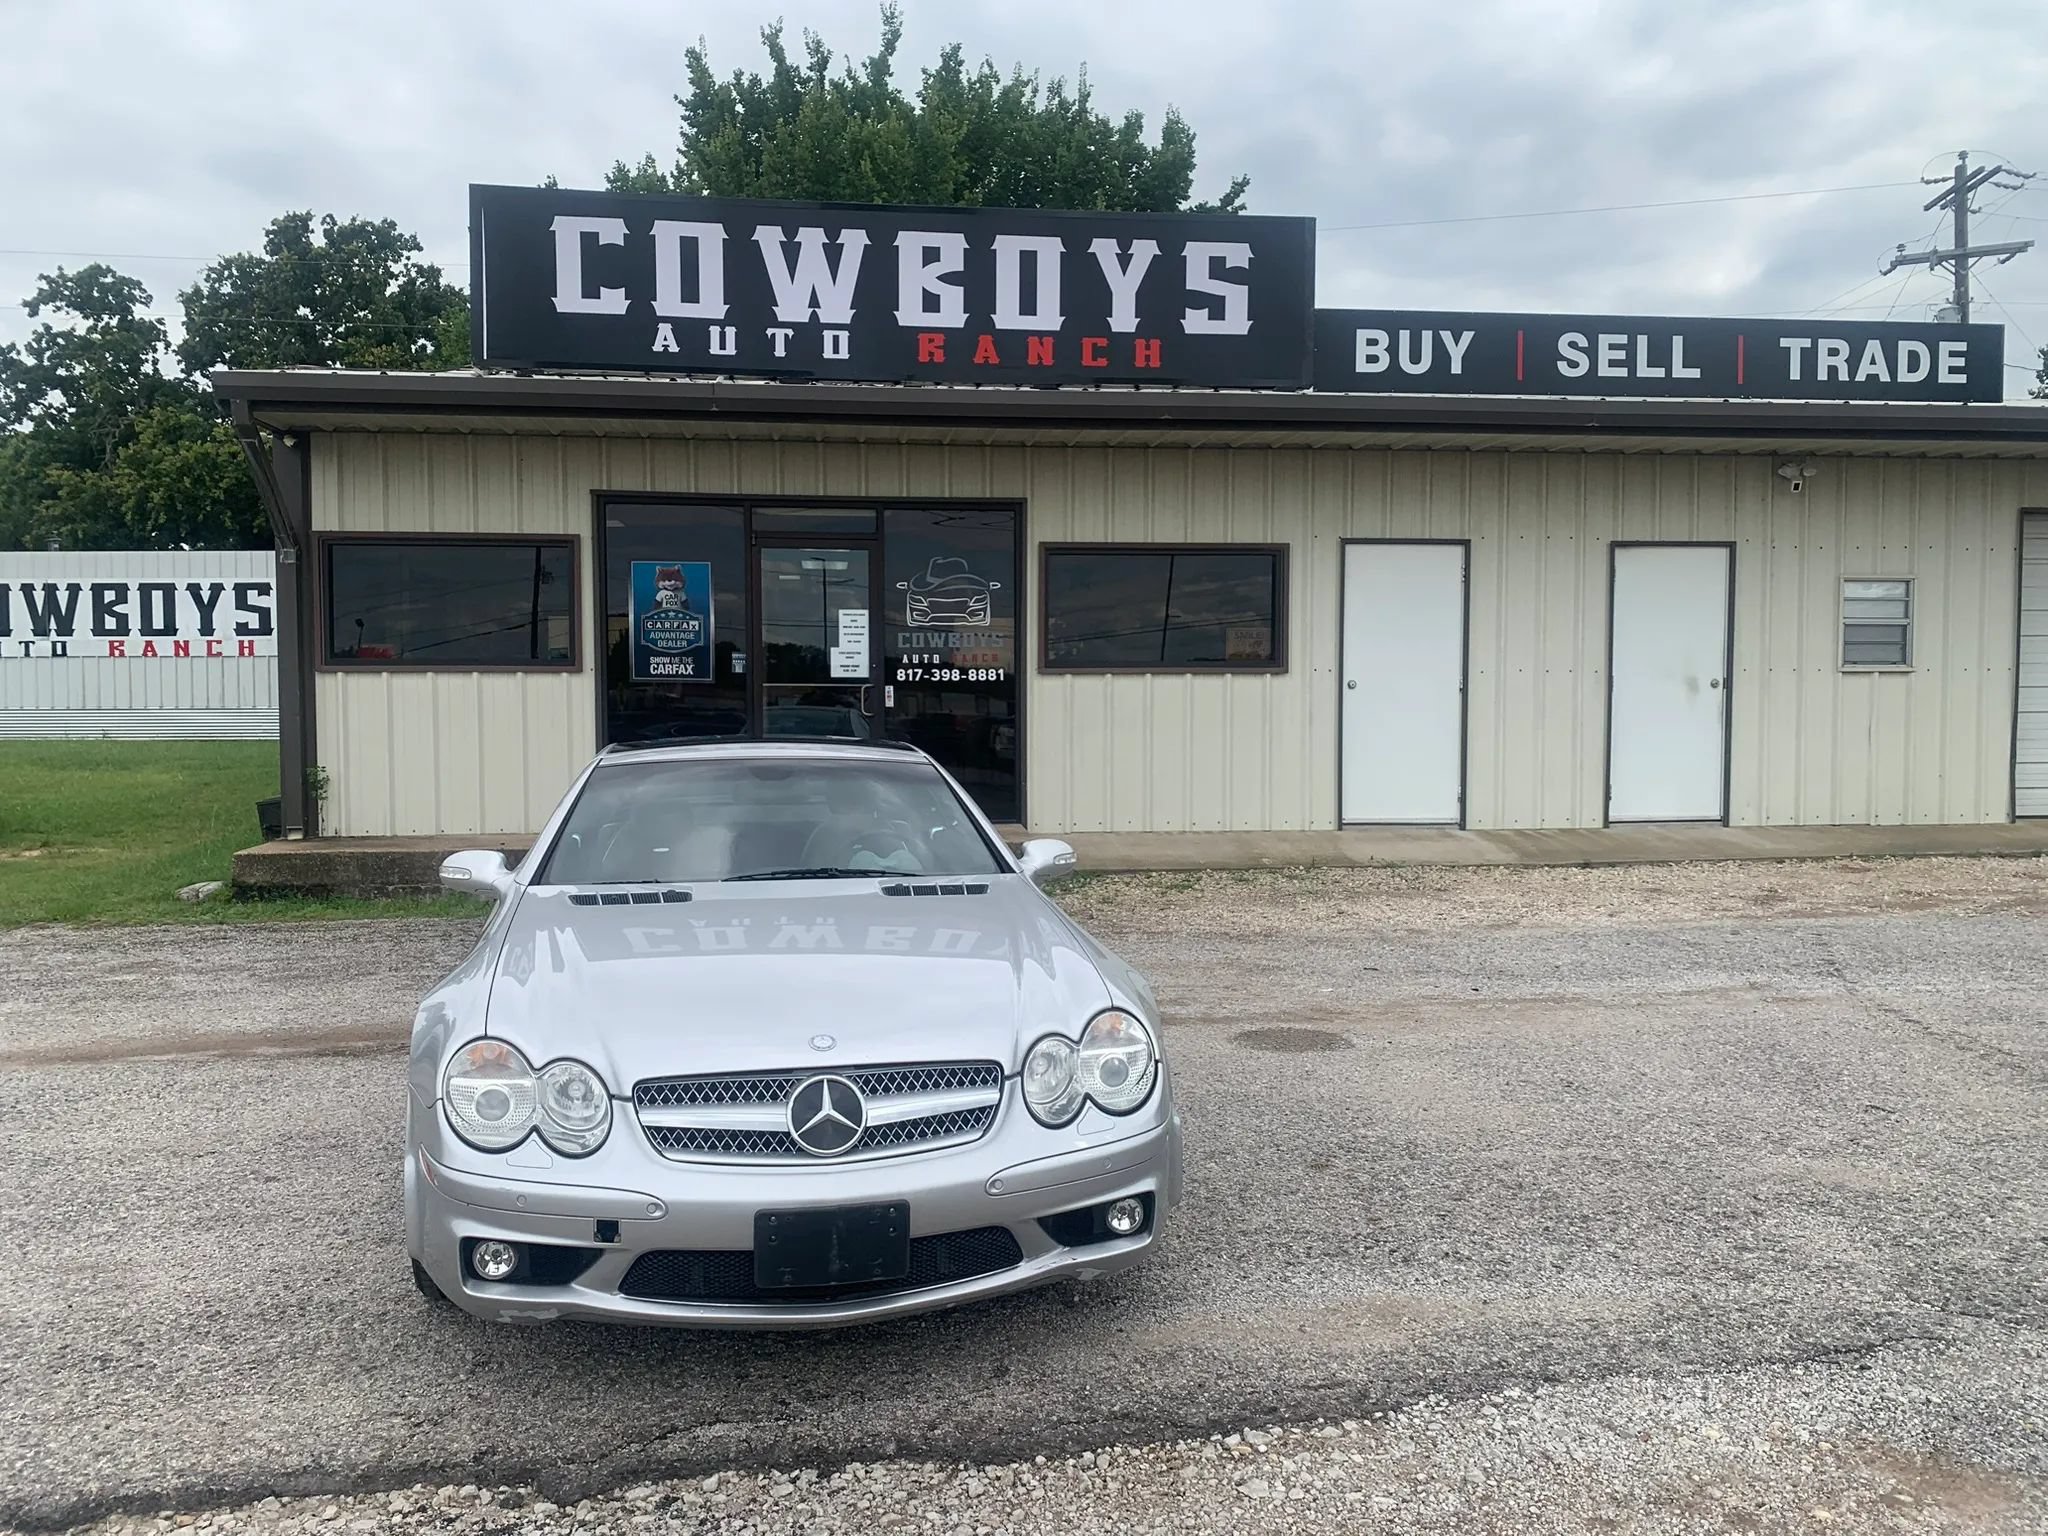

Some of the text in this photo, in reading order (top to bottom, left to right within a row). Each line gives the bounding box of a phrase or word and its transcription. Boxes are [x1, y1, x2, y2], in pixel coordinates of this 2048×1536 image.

[549, 214, 1254, 336] COWBOYS
[651, 322, 1162, 369] AUTO RANCH
[1354, 328, 1969, 385] BUY SELL TRADE
[645, 620, 699, 630] CARFAX
[649, 631, 696, 640] ADVANTAGE
[897, 632, 1005, 648] COWBOYS
[0, 640, 255, 657] TO RANCH
[657, 639, 688, 648] DEALER
[649, 656, 694, 664] SHOW ME THE
[902, 654, 940, 664] AUTO
[649, 664, 694, 675] CARFAX
[896, 668, 1005, 681] 817-398-8881
